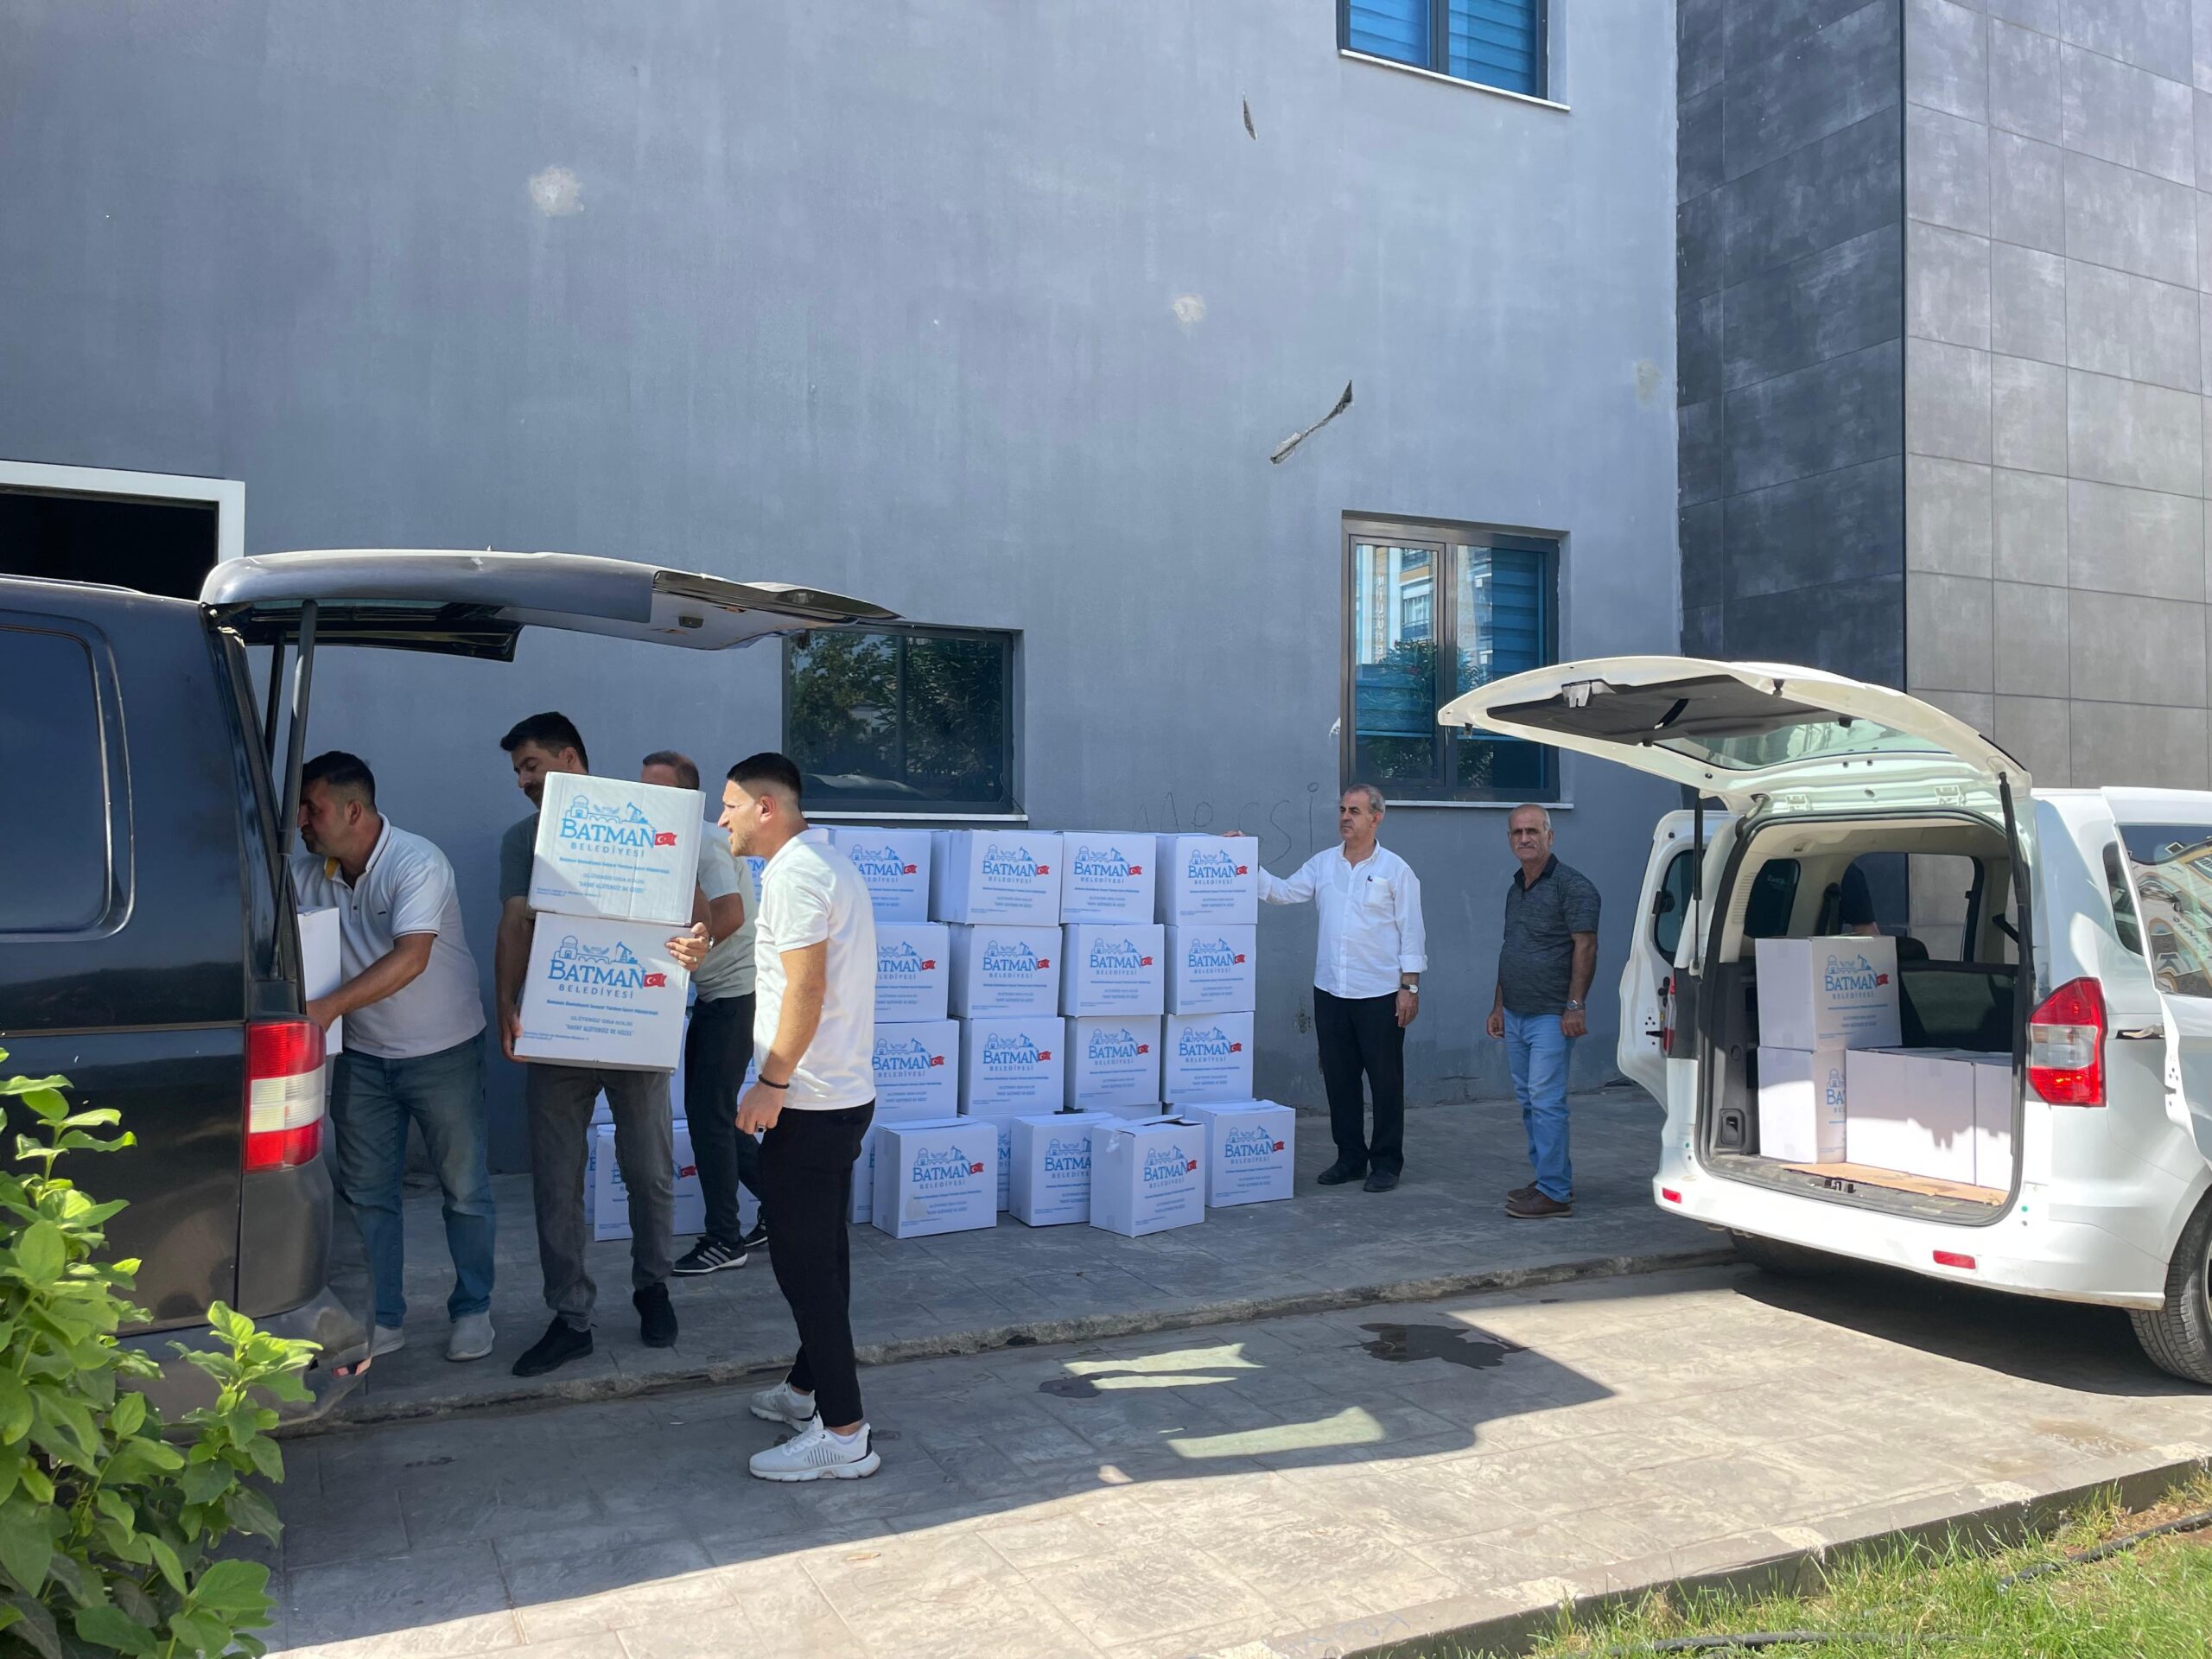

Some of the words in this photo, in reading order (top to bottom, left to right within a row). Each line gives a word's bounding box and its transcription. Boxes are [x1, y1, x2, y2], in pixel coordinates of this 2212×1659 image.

[560, 818, 657, 849] BATMAN
[570, 842, 645, 857] BELEDİYESİ
[854, 863, 905, 876] ATMAN
[982, 861, 1038, 877] BATMAN
[1074, 861, 1130, 877] BATMAN
[1188, 864, 1237, 878] BATMAN
[982, 957, 1038, 972] BATMAN
[1090, 955, 1141, 969] BATMAN
[1188, 953, 1236, 968] BATMAN
[548, 959, 646, 989] BATMAN
[1825, 974, 1878, 992] BATMAN
[558, 984, 633, 1000] BELEDİYESİ
[982, 1050, 1039, 1064] BATMAN
[1089, 1044, 1138, 1059] BATMAN
[1179, 1042, 1231, 1057] BATMAN
[872, 1054, 931, 1071] BATMAN
[1224, 1141, 1274, 1158] BATMAN
[1045, 1157, 1091, 1172] BATMA
[1143, 1160, 1188, 1182] BATMAN
[912, 1162, 971, 1183] BATMAN
